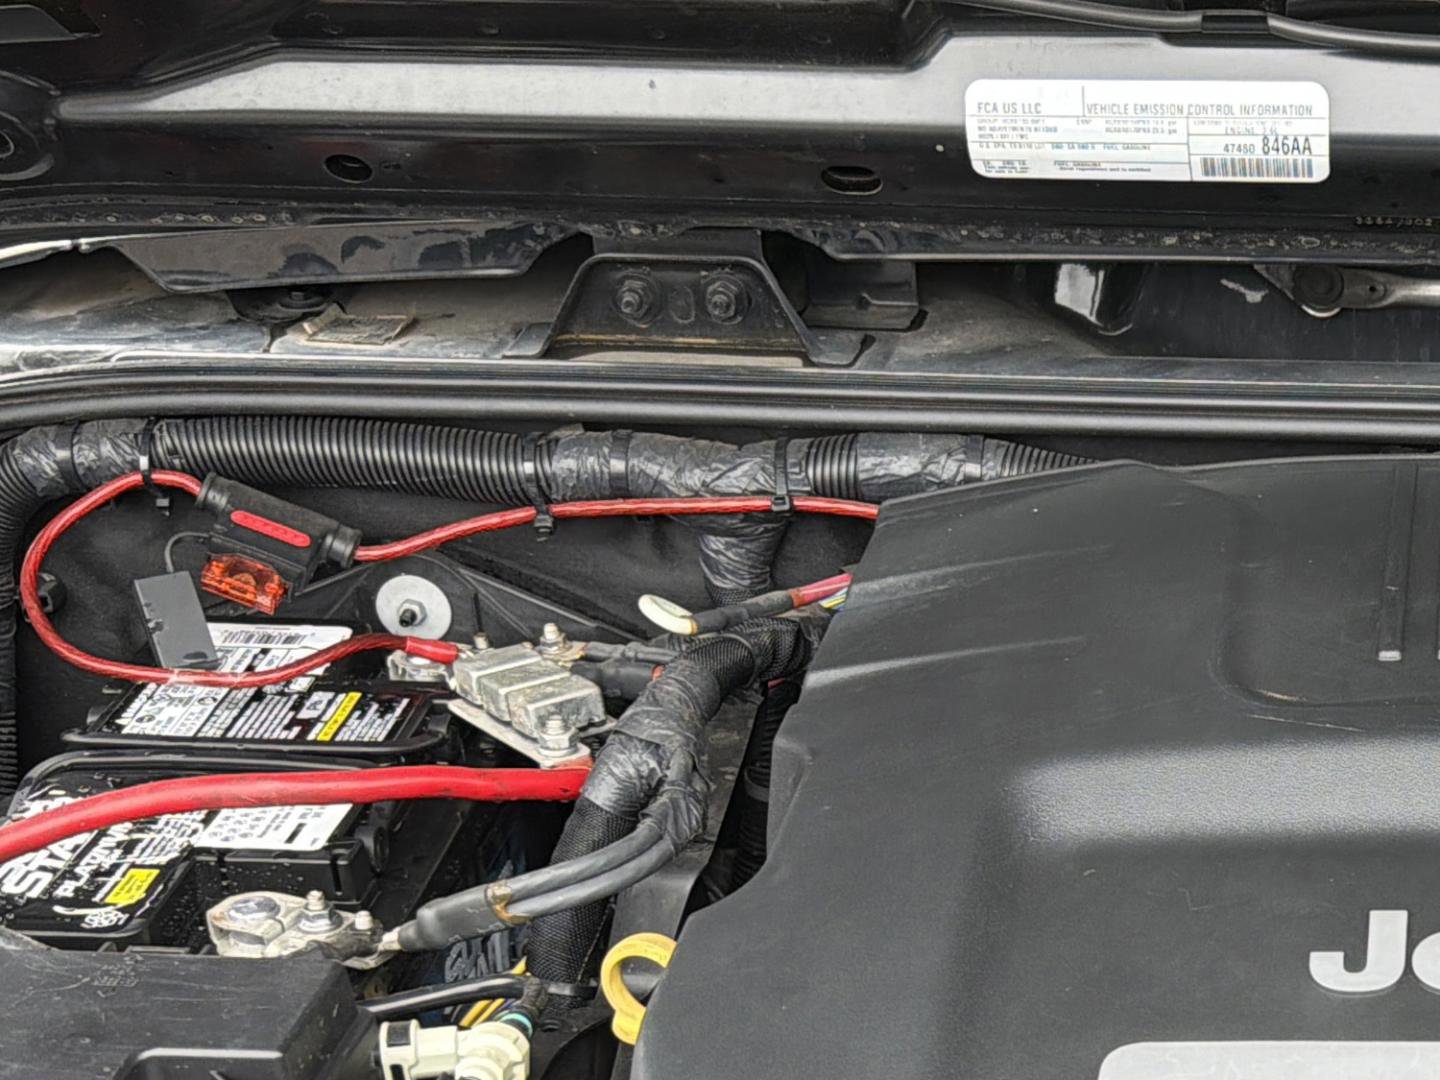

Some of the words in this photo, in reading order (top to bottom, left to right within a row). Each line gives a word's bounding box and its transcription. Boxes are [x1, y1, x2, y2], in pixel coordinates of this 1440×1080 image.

[977, 102, 999, 115] FCA
[1003, 102, 1018, 115] US
[1021, 102, 1042, 115] LLC
[1086, 102, 1129, 116] VEHICLE
[1133, 103, 1184, 116] EMISSION
[1187, 103, 1235, 116] CONTROL
[1239, 104, 1313, 116] INFORMATION
[1262, 135, 1313, 156] 846AA
